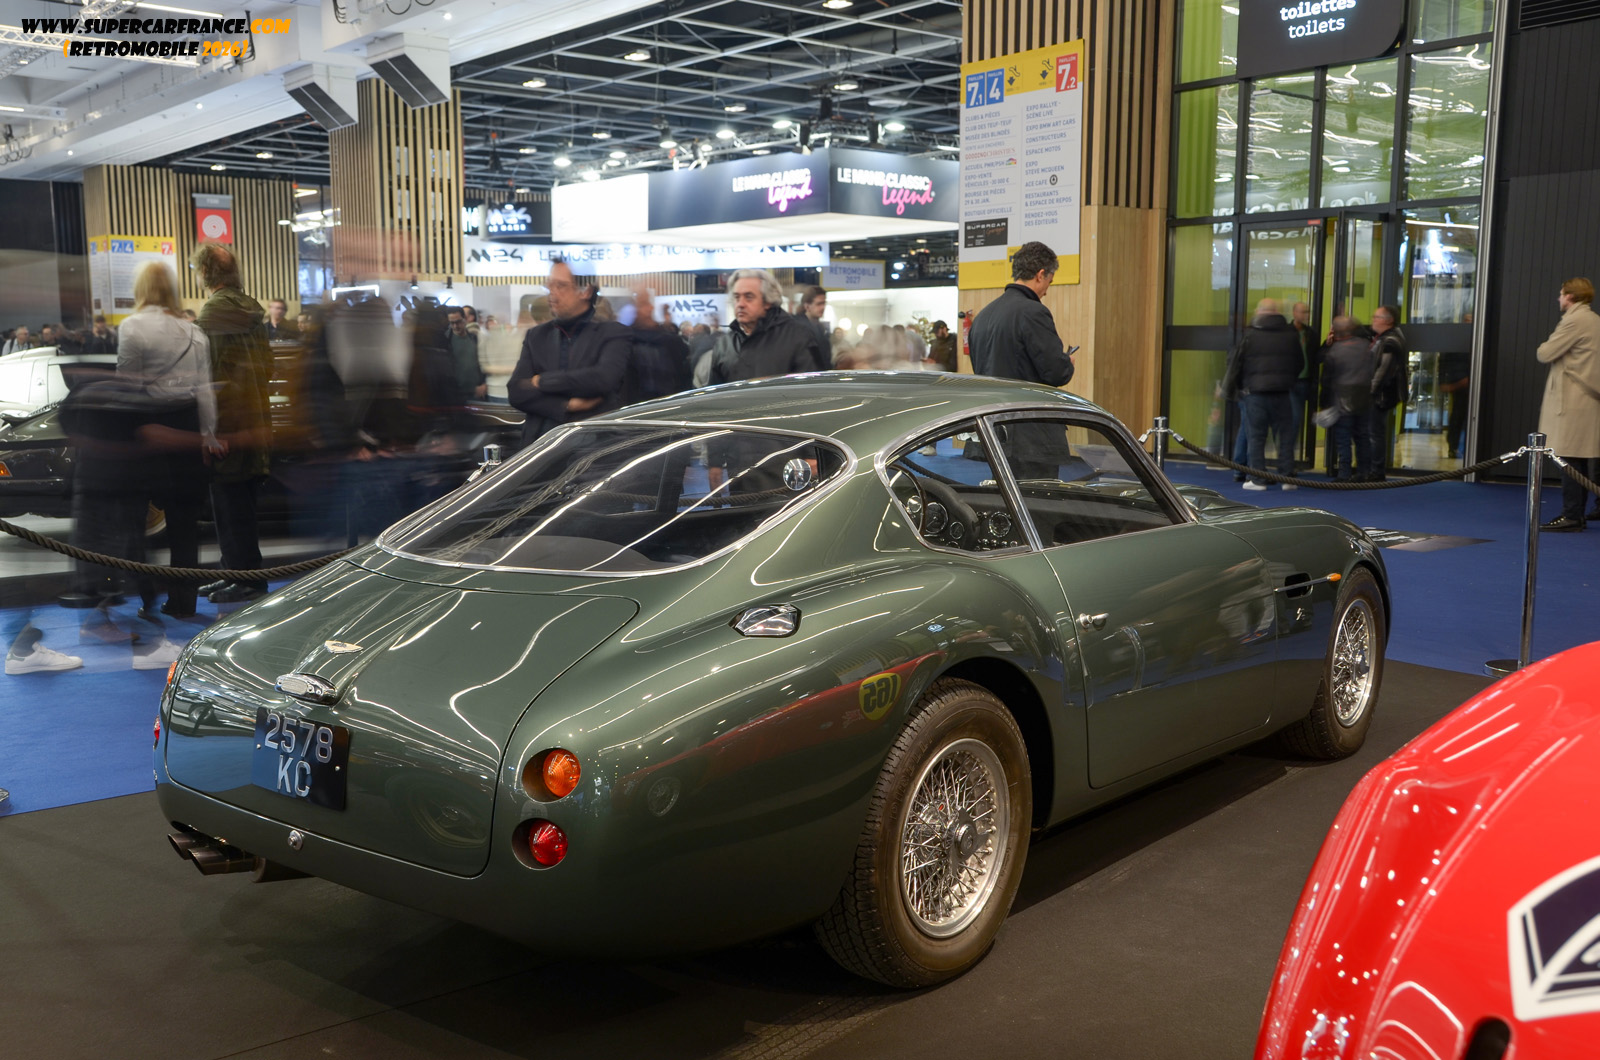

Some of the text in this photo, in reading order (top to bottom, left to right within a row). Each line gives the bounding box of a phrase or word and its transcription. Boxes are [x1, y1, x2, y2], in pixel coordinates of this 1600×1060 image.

[1279, 0, 1356, 20] toilettes
[1288, 18, 1345, 38] toilets
[1058, 63, 1076, 90] 7.2
[989, 77, 1001, 100] 4
[967, 82, 983, 107] 7.1
[1026, 104, 1039, 112] EXPO
[1040, 101, 1058, 109] RALLYE
[965, 114, 980, 122] CLUBS
[965, 124, 977, 132] CLUB
[1026, 118, 1076, 132] EXPO BMW ART CARS
[1025, 132, 1067, 144] CONSTRUCTEURS
[1025, 145, 1062, 156] ESPACE MOTOS
[1025, 168, 1041, 176] STEVE
[837, 167, 851, 183] LE
[886, 172, 930, 190] CLASSIC
[1025, 180, 1034, 188] ACE
[882, 181, 933, 215] Legend
[1025, 190, 1059, 199] RESTAURANTS
[1030, 199, 1048, 207] ESPACE
[1056, 196, 1072, 204] REPOS
[1024, 210, 1058, 219] RENDEZ-VOUS
[966, 222, 1006, 230] SUPERCAR
[1024, 219, 1034, 227] DES
[264, 713, 333, 764] 2578
[276, 754, 311, 797] KC
